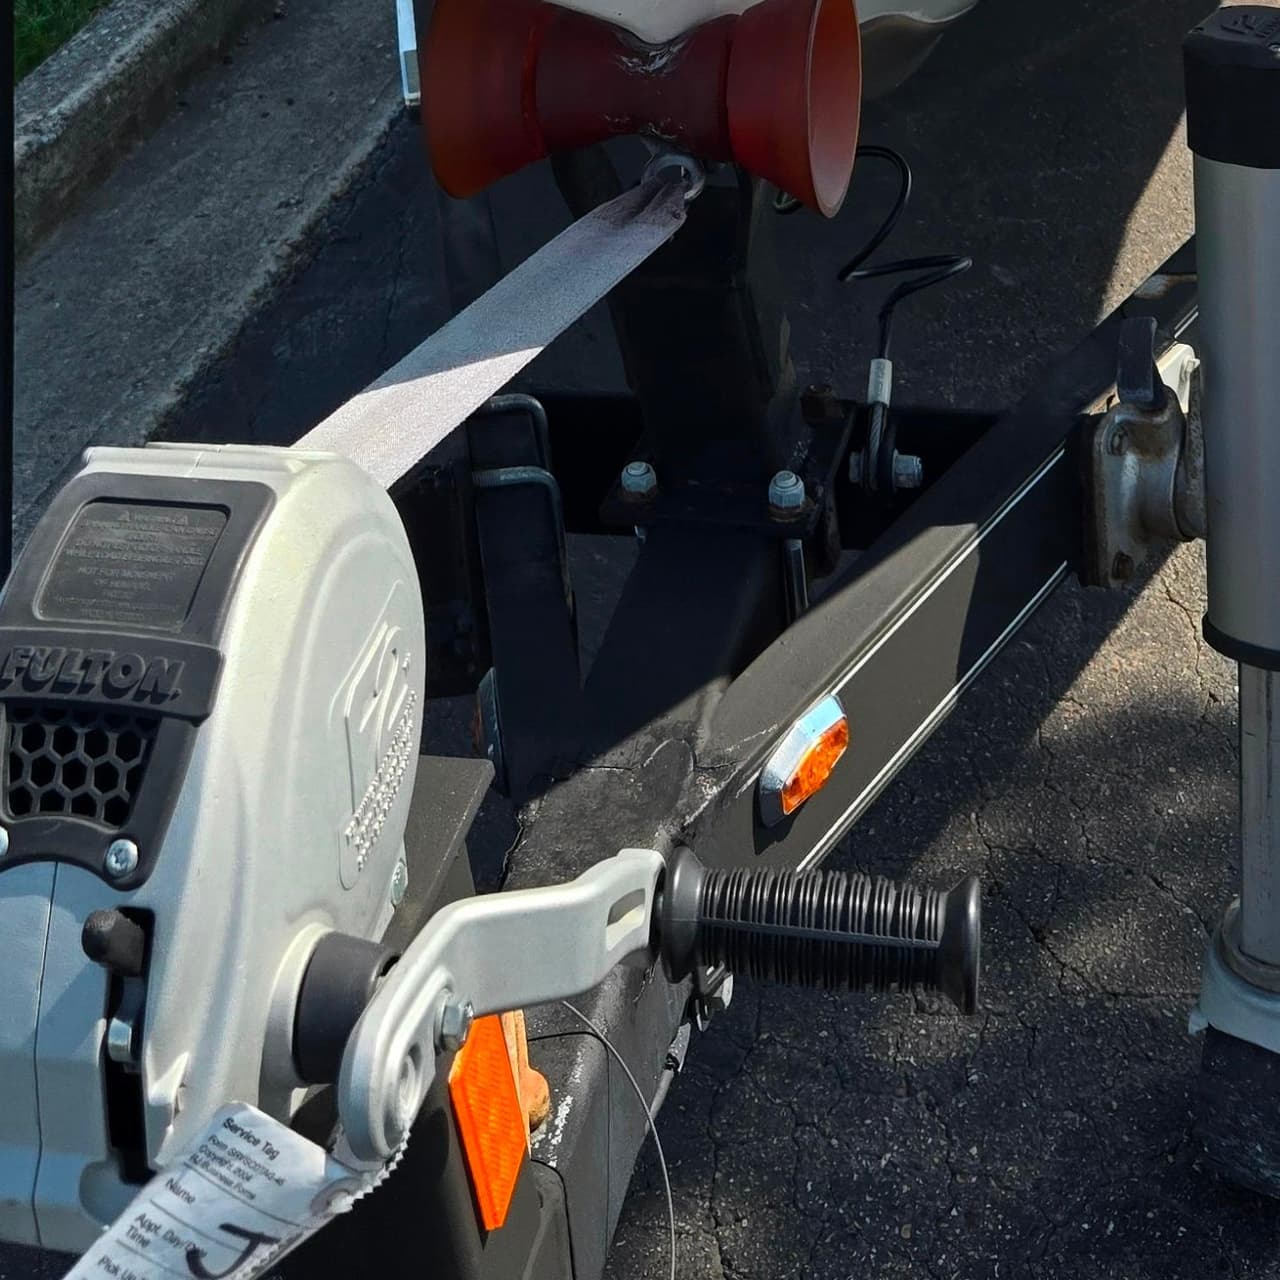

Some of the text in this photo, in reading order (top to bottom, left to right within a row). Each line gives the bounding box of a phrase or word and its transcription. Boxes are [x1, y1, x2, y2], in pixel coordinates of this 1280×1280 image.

[223, 1117, 281, 1161] Service Tag
[165, 1177, 196, 1204] Name
[126, 1224, 151, 1248] Time
[98, 1254, 121, 1276] Pick
